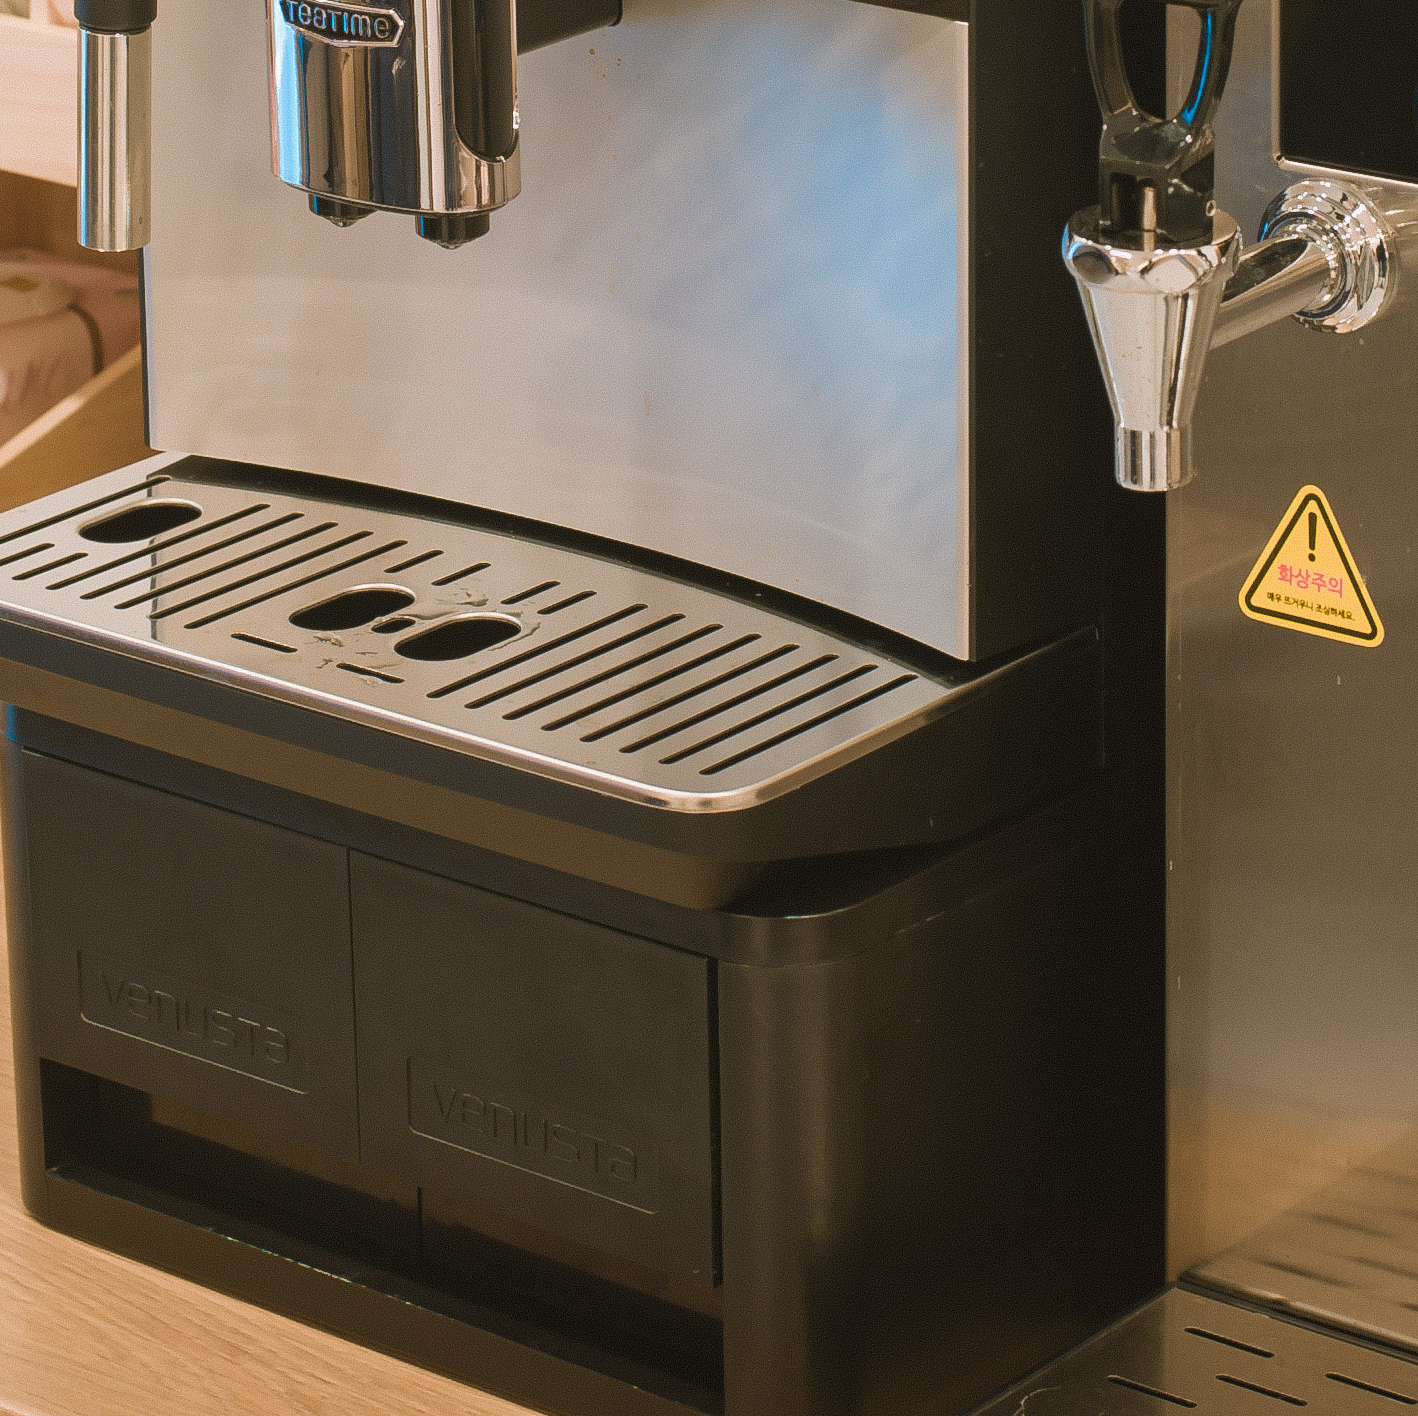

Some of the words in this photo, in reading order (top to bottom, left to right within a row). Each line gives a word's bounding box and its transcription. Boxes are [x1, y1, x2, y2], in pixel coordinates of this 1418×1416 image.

[1277, 563, 1344, 600] 화상주의
[1266, 591, 1283, 603] 매우
[1284, 595, 1314, 610] 뜨거우니
